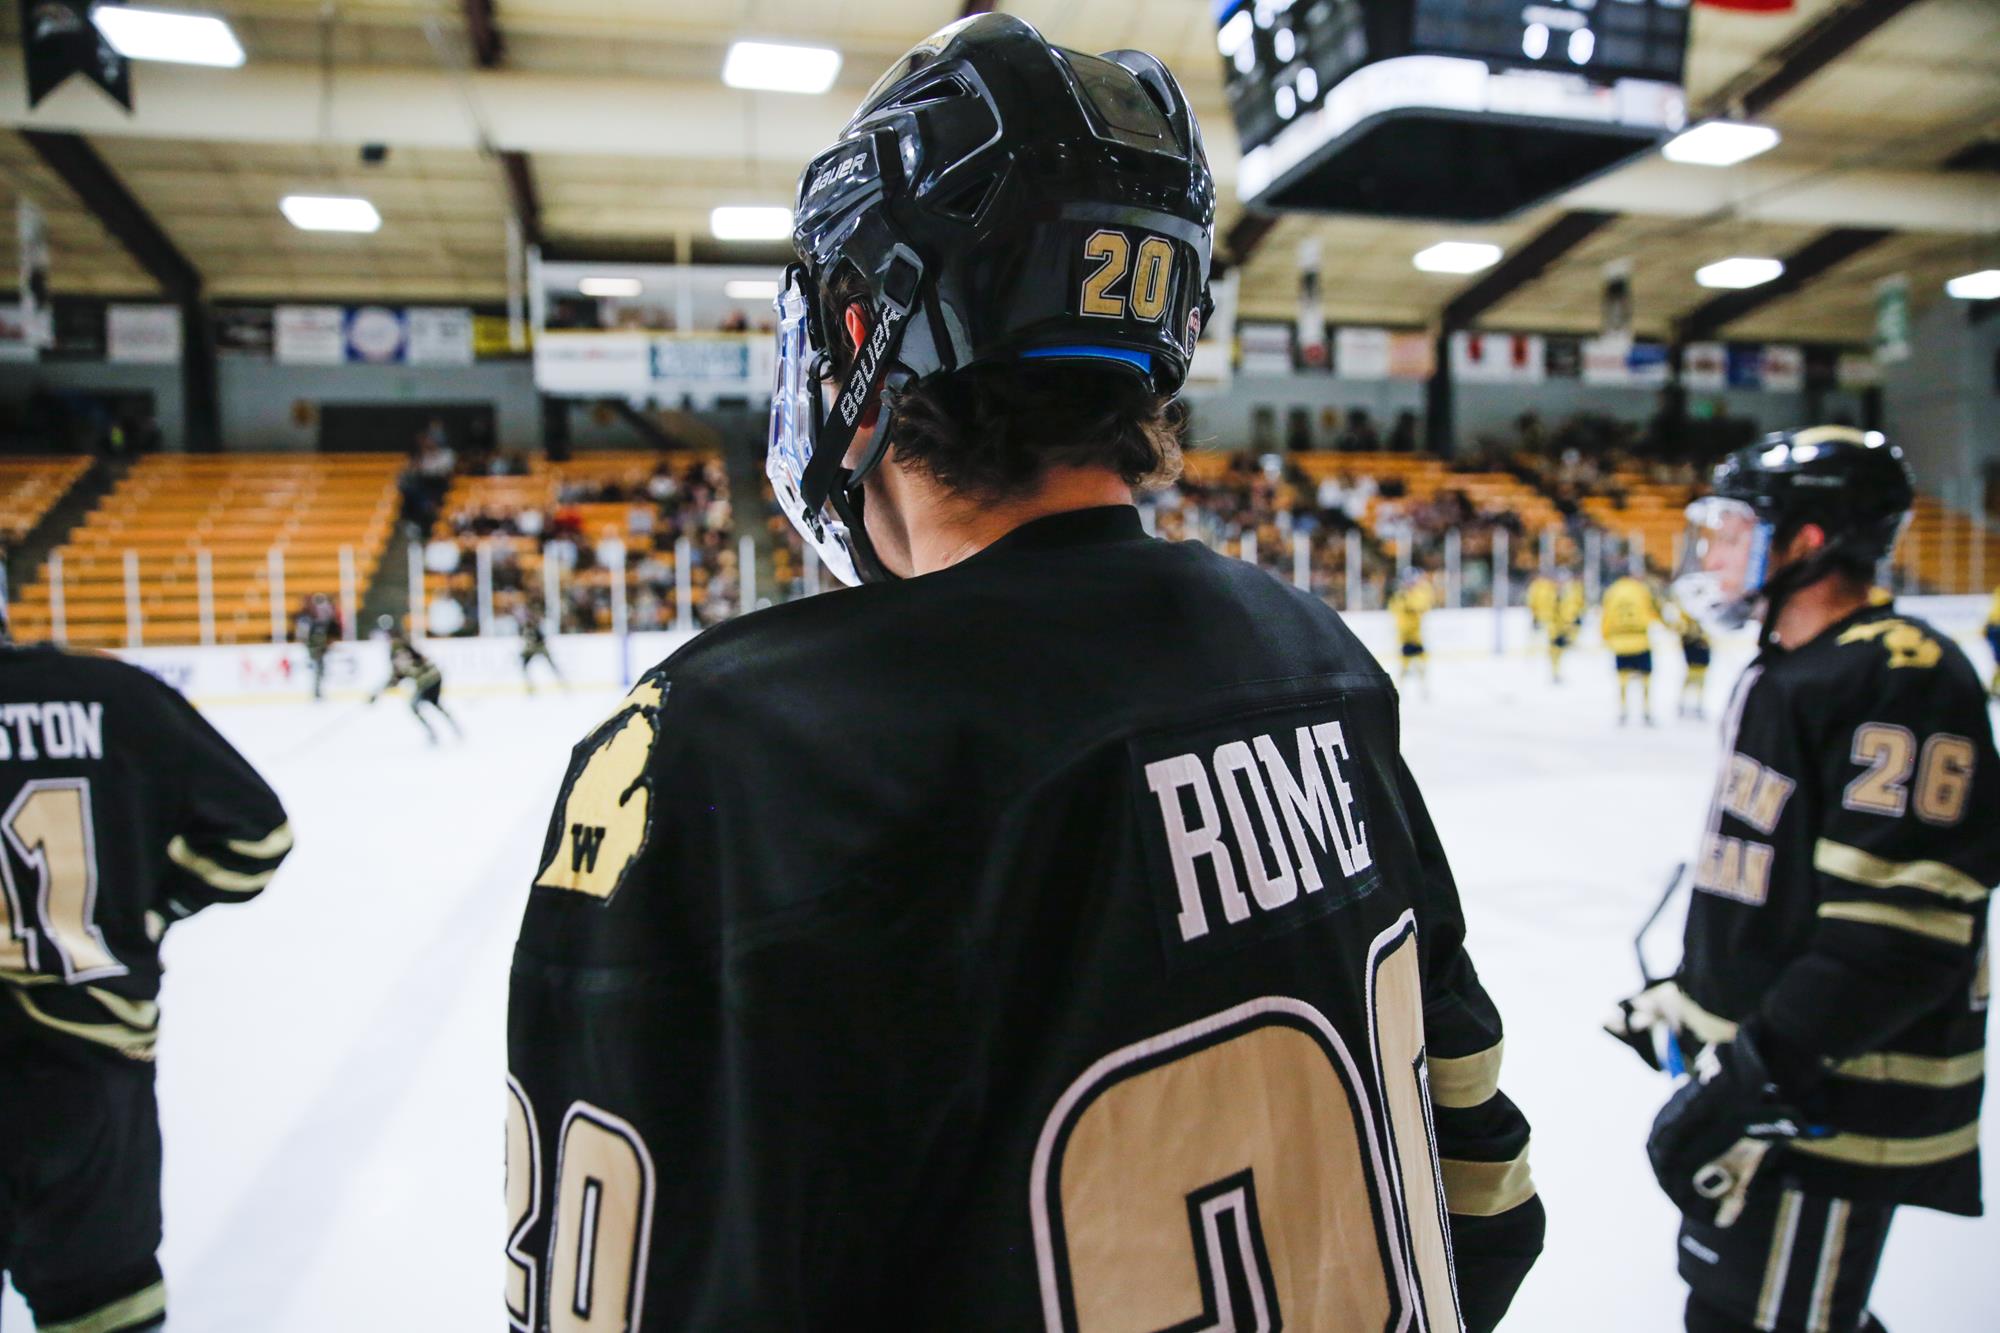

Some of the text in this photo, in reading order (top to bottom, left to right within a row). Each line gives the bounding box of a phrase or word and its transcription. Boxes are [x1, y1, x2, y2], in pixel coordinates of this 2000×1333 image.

[808, 152, 868, 197] BAUER
[1079, 229, 1175, 323] 20
[840, 304, 902, 427] BAUER
[1842, 721, 1978, 826] 26
[571, 823, 606, 874] W
[1145, 720, 1374, 942] ROME
